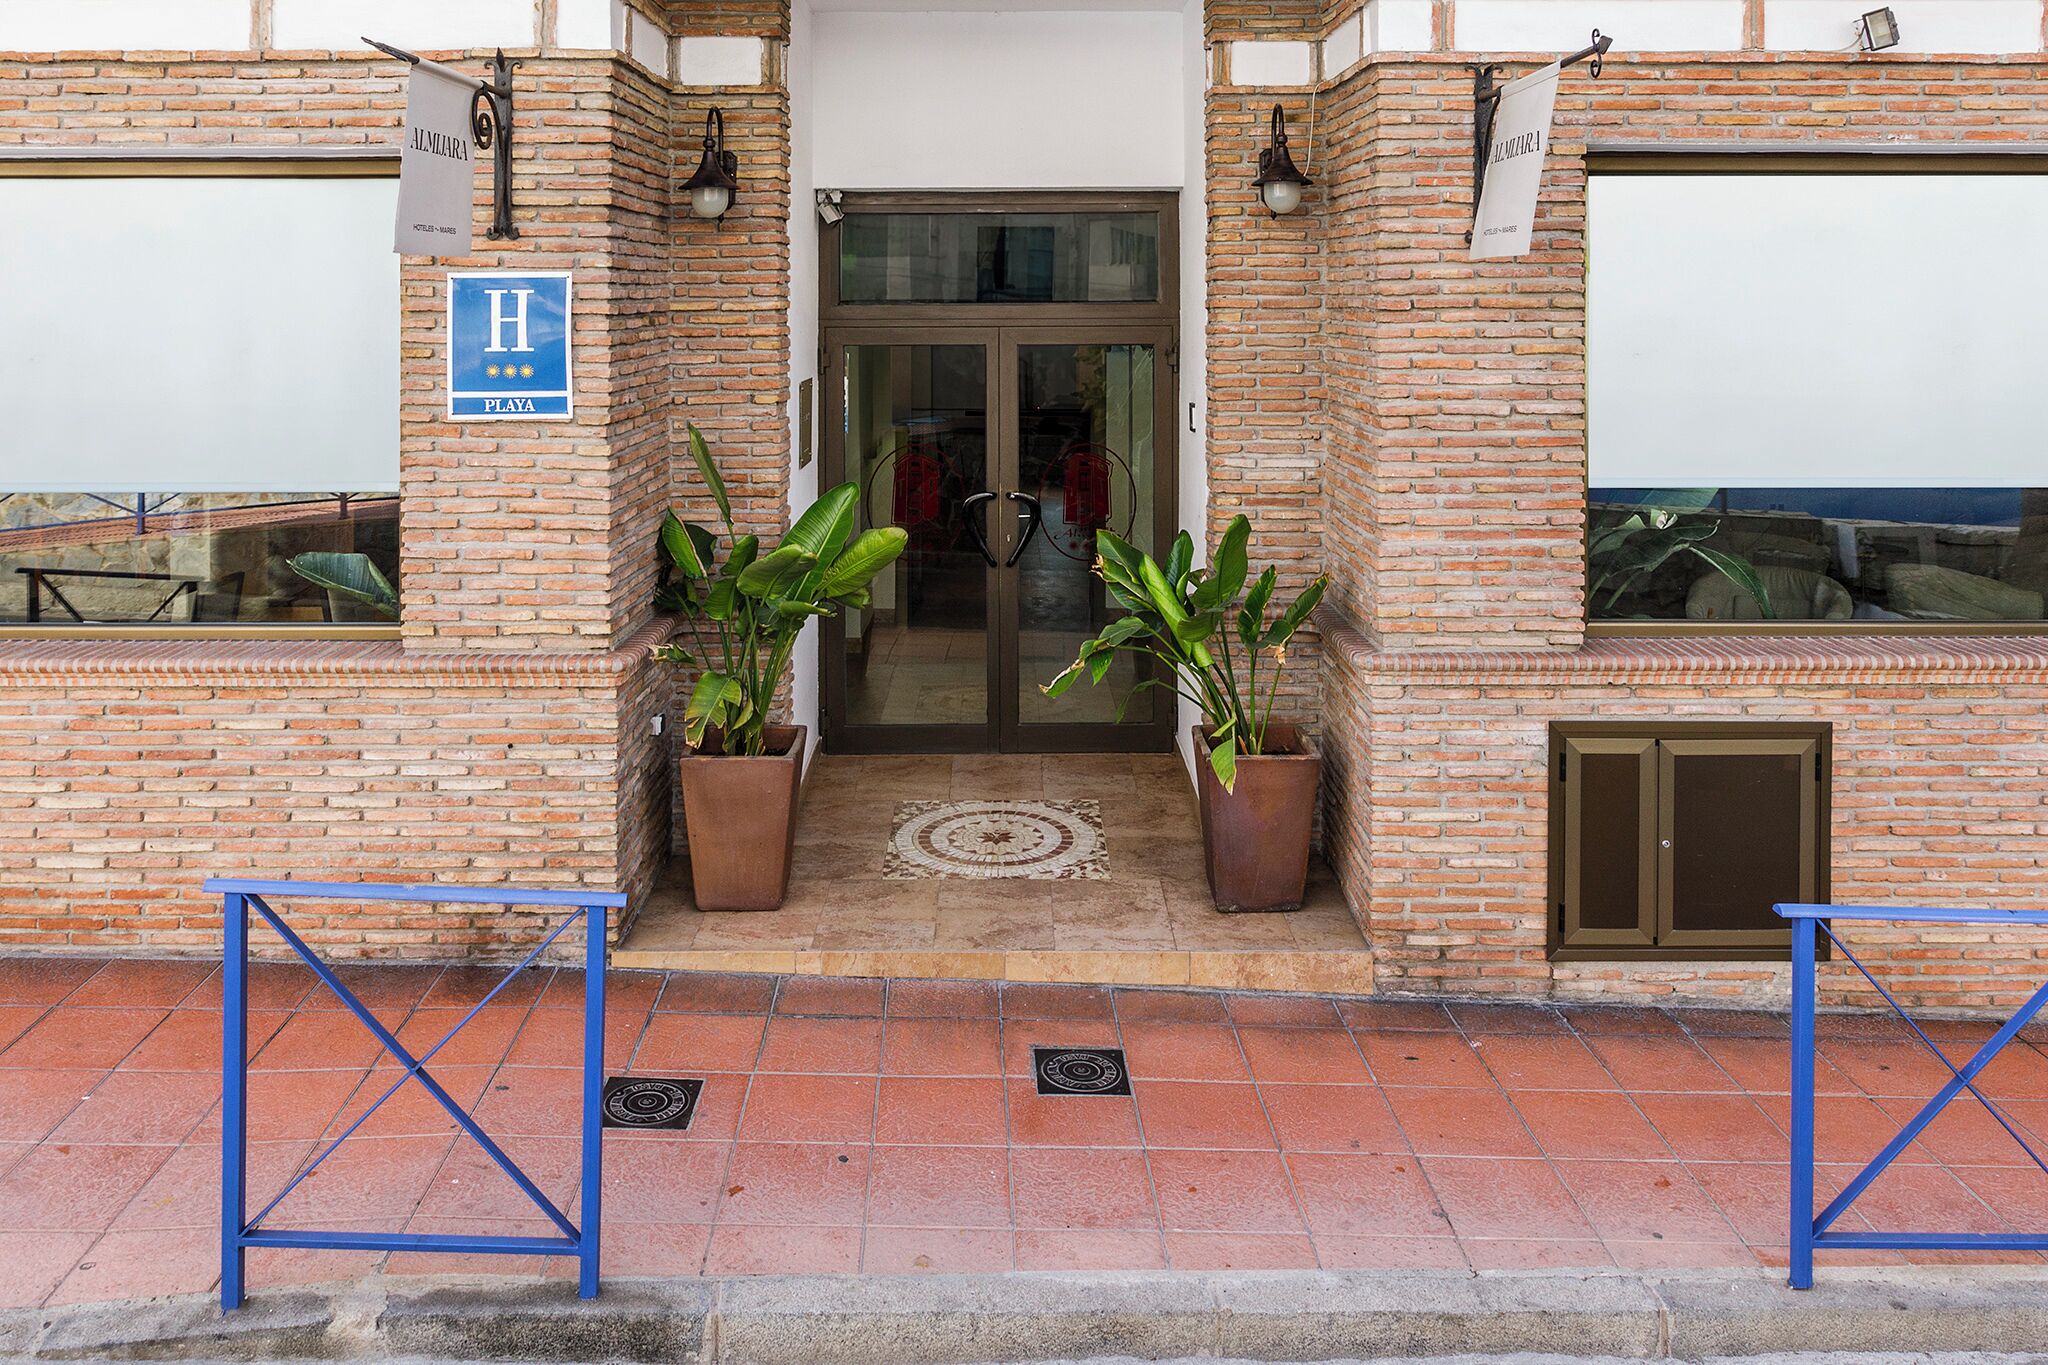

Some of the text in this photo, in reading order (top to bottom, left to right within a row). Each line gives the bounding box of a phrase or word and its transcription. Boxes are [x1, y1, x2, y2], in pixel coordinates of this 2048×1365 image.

[409, 126, 469, 161] ALMIJARA
[1490, 130, 1542, 165] ALMIJARA
[412, 223, 457, 235] HOTELES MARES
[483, 289, 535, 353] H
[483, 398, 536, 413] PLAYA
